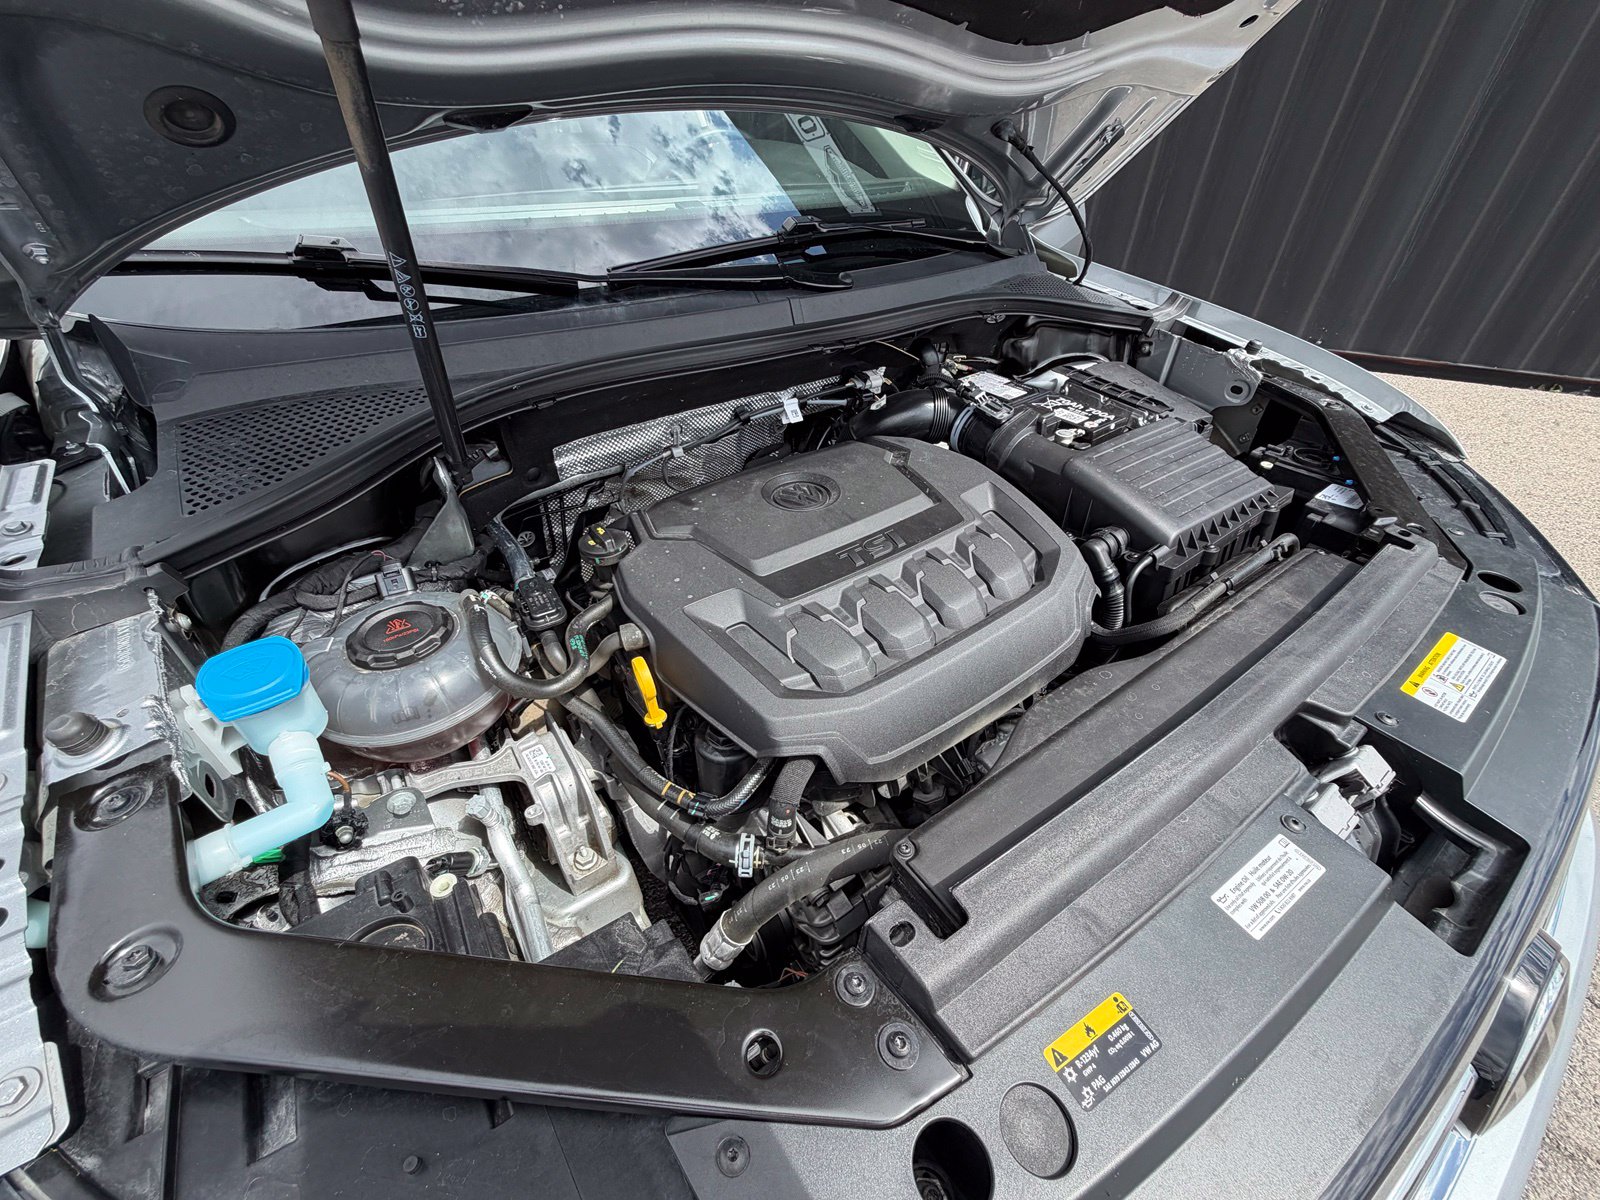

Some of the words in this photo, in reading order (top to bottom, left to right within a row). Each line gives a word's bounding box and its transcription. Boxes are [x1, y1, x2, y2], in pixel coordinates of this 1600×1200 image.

[835, 529, 906, 567] TSI
[1247, 866, 1261, 877] Huile
[1257, 855, 1272, 868] moteur
[1229, 881, 1245, 894] Engine
[1240, 874, 1250, 884] Oil
[1248, 902, 1259, 912] VW
[1074, 1044, 1100, 1069] R-1234yf
[1118, 1022, 1130, 1032] kg
[1139, 1045, 1152, 1058] VW
[1149, 1039, 1160, 1051] AG
[1090, 1074, 1106, 1091] PAG
